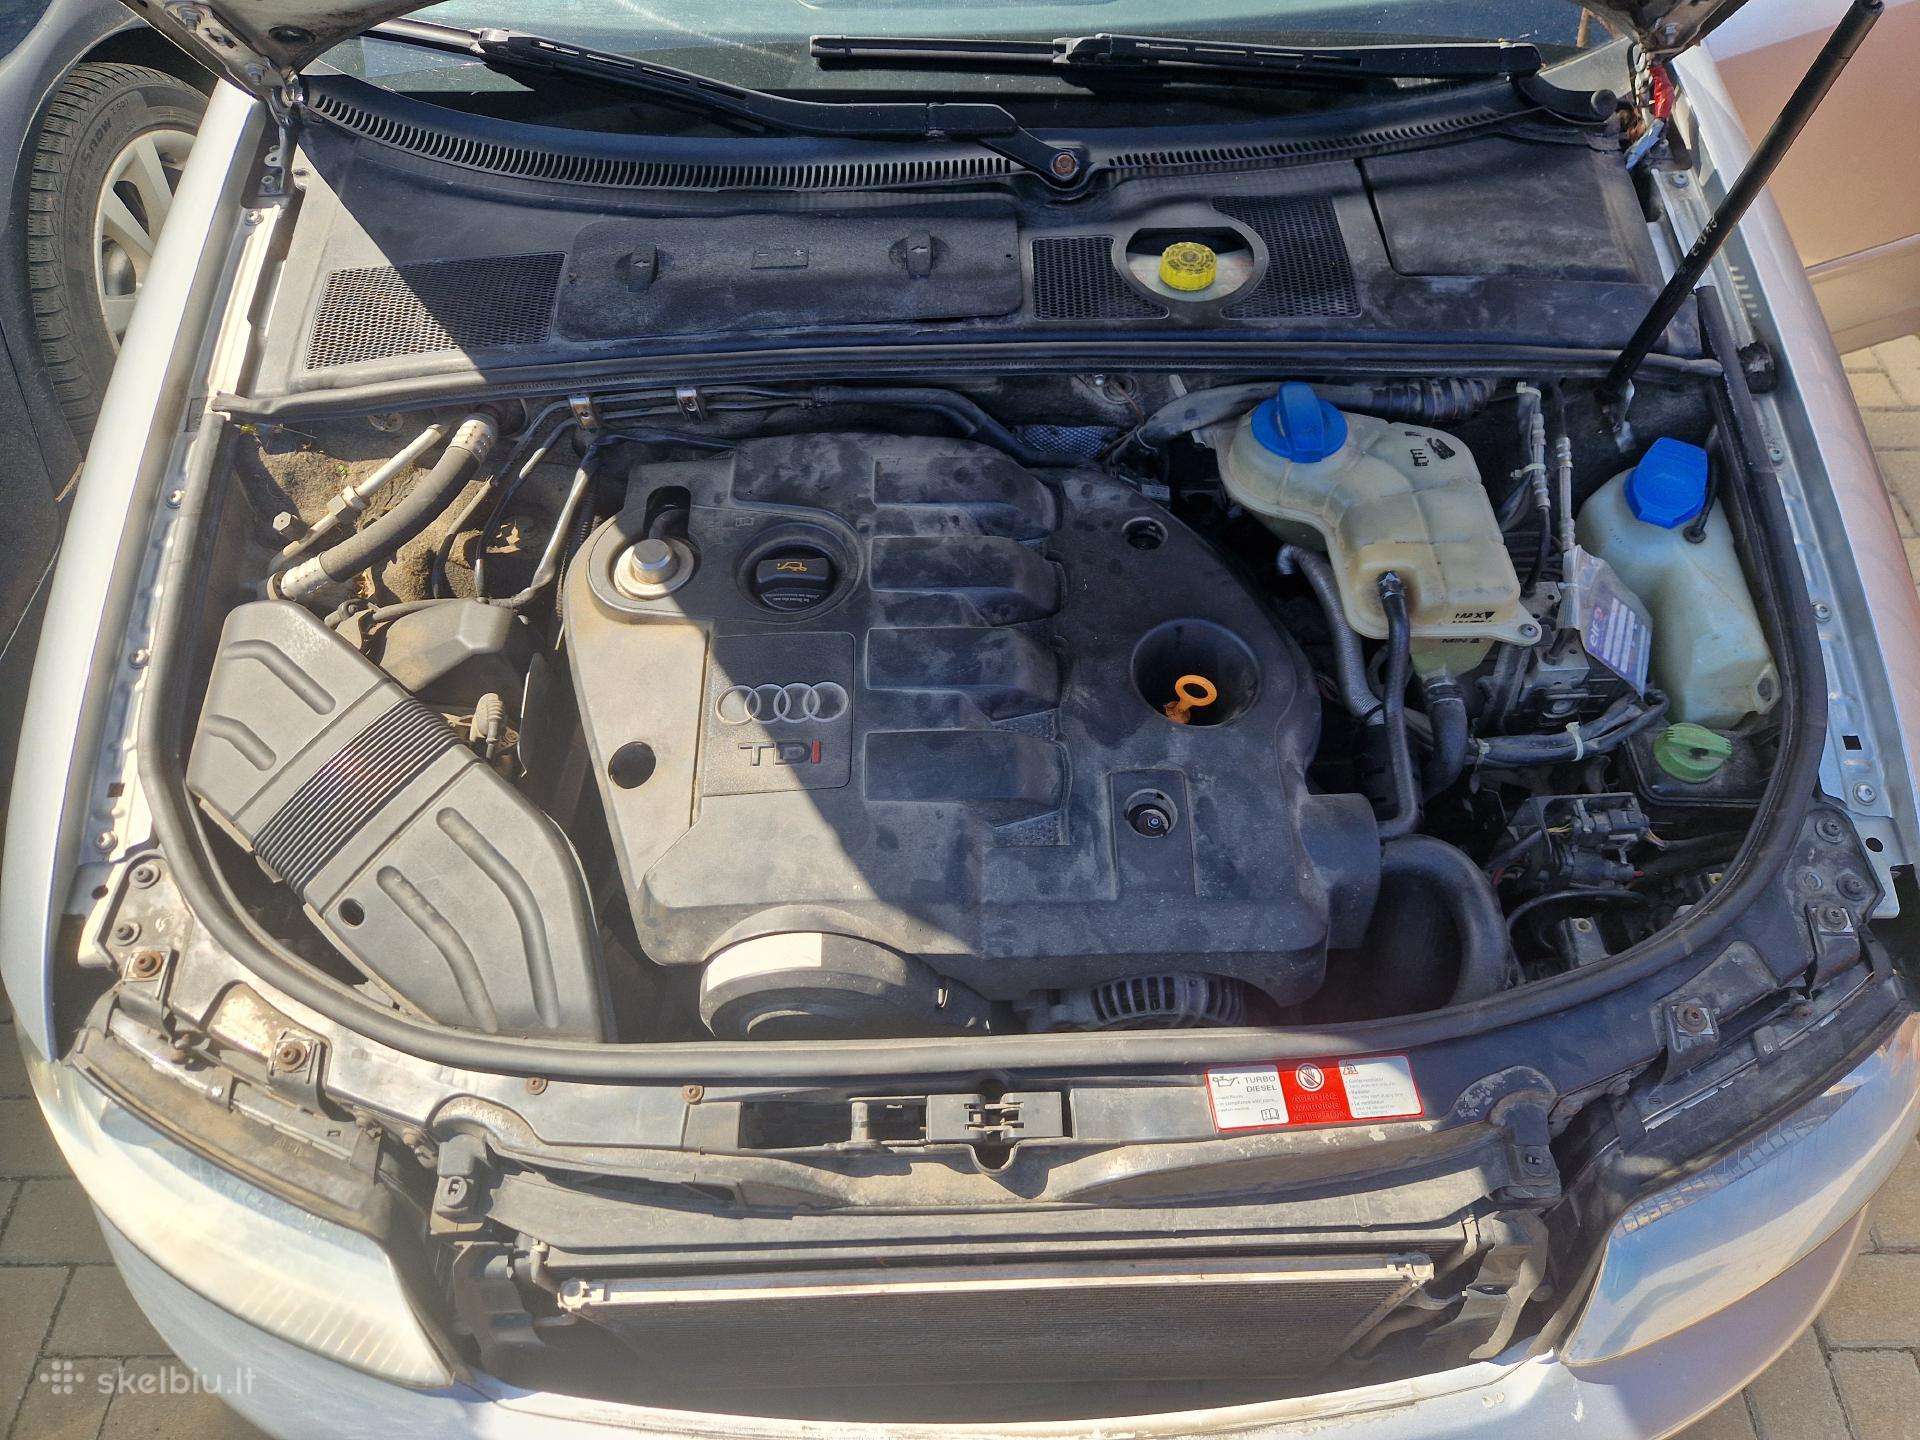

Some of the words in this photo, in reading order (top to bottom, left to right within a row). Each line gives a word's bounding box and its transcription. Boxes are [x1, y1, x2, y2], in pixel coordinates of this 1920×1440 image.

[1589, 619, 1601, 648] elf
[737, 739, 821, 767] TDI
[1244, 1075, 1276, 1084] TURBO
[1246, 1084, 1278, 1093] DIESEL
